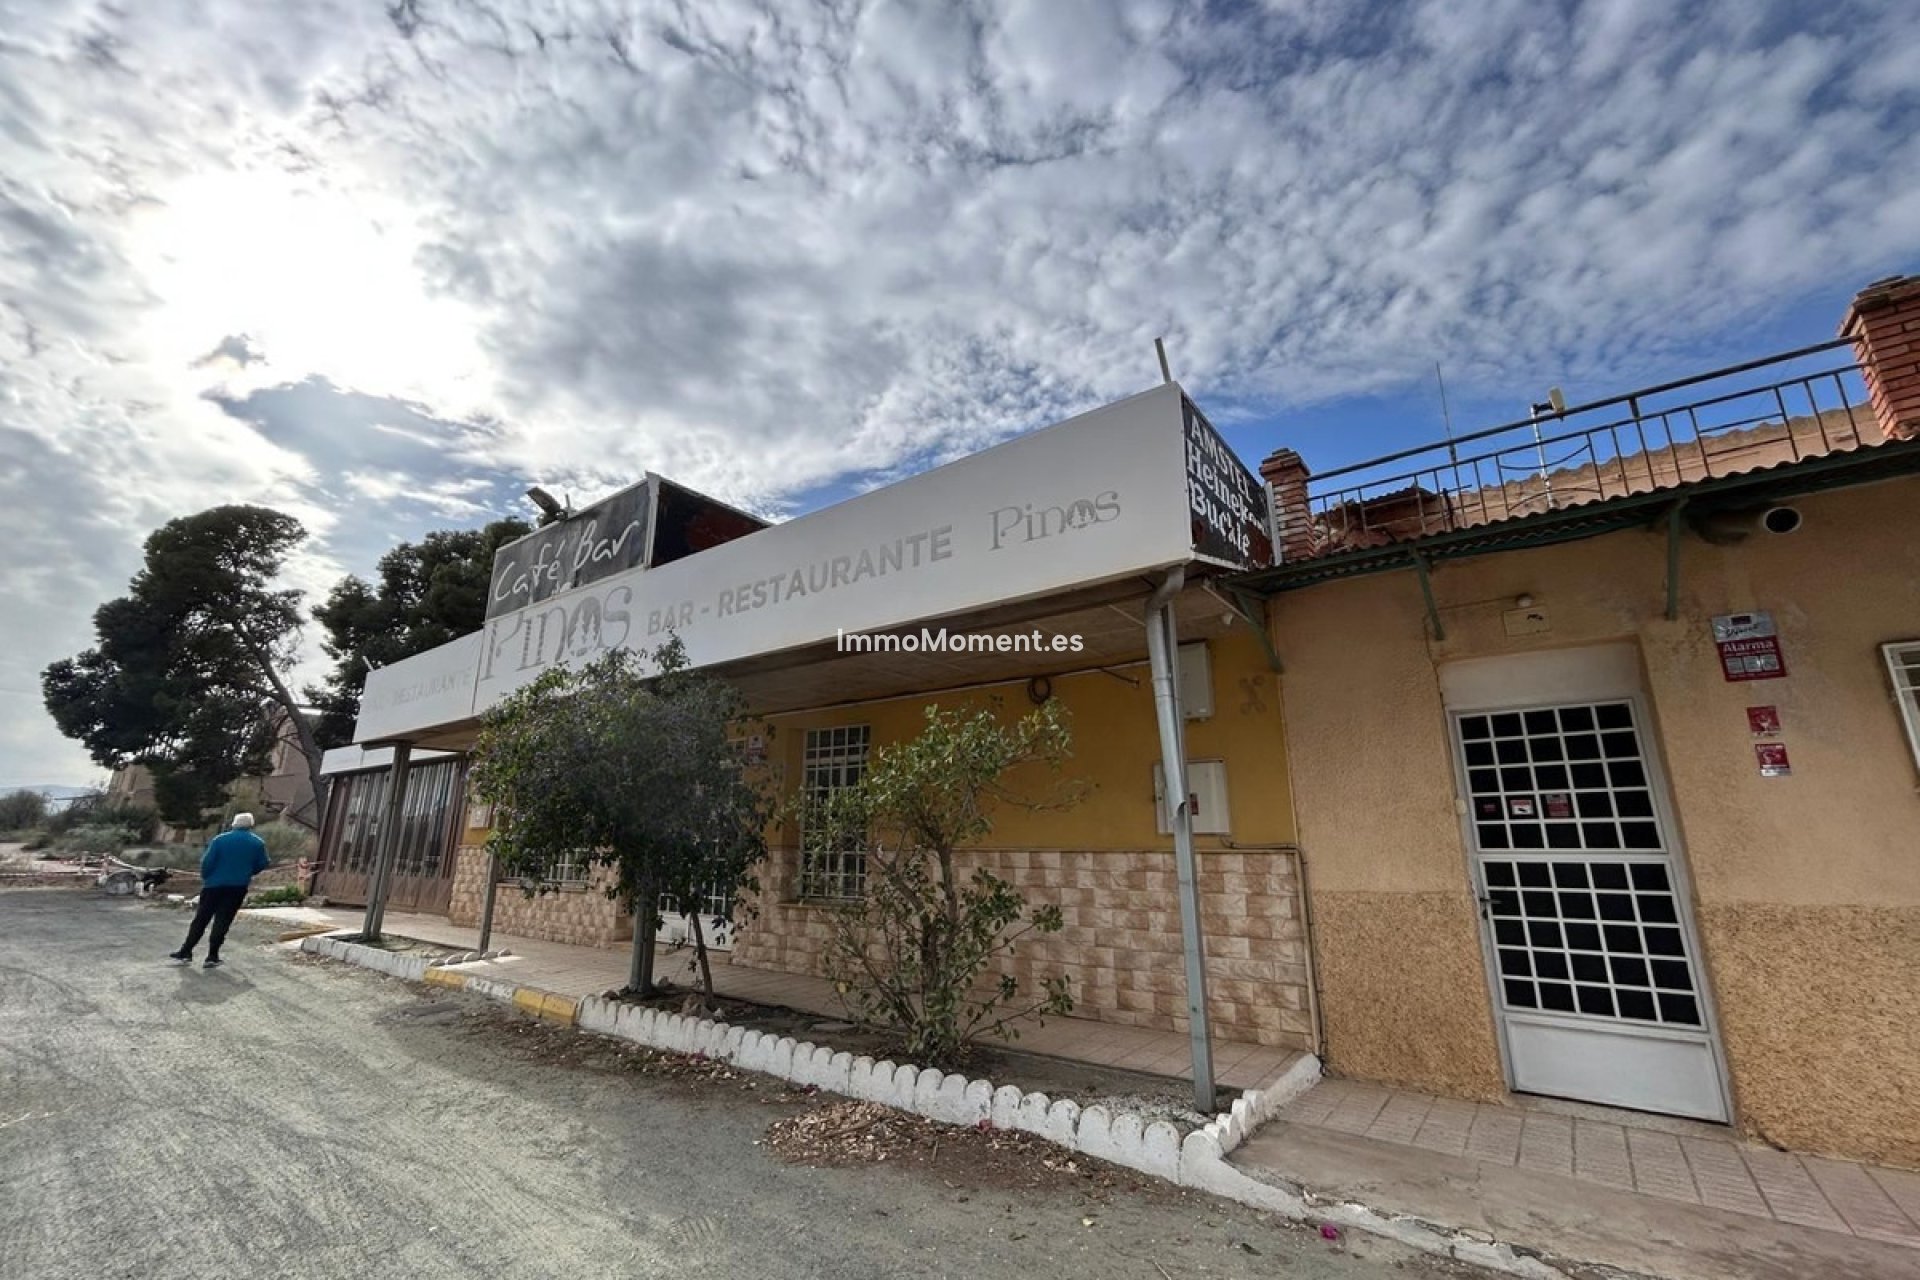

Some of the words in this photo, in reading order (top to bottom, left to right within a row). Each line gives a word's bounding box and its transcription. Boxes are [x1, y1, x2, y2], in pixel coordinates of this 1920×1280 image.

[1191, 415, 1254, 504] AMSTEL
[494, 539, 565, 602] Café
[573, 519, 640, 573] Bar
[647, 600, 694, 636] BAR
[717, 524, 953, 618] RESTAURANTE
[1723, 640, 1774, 652] Alarma
